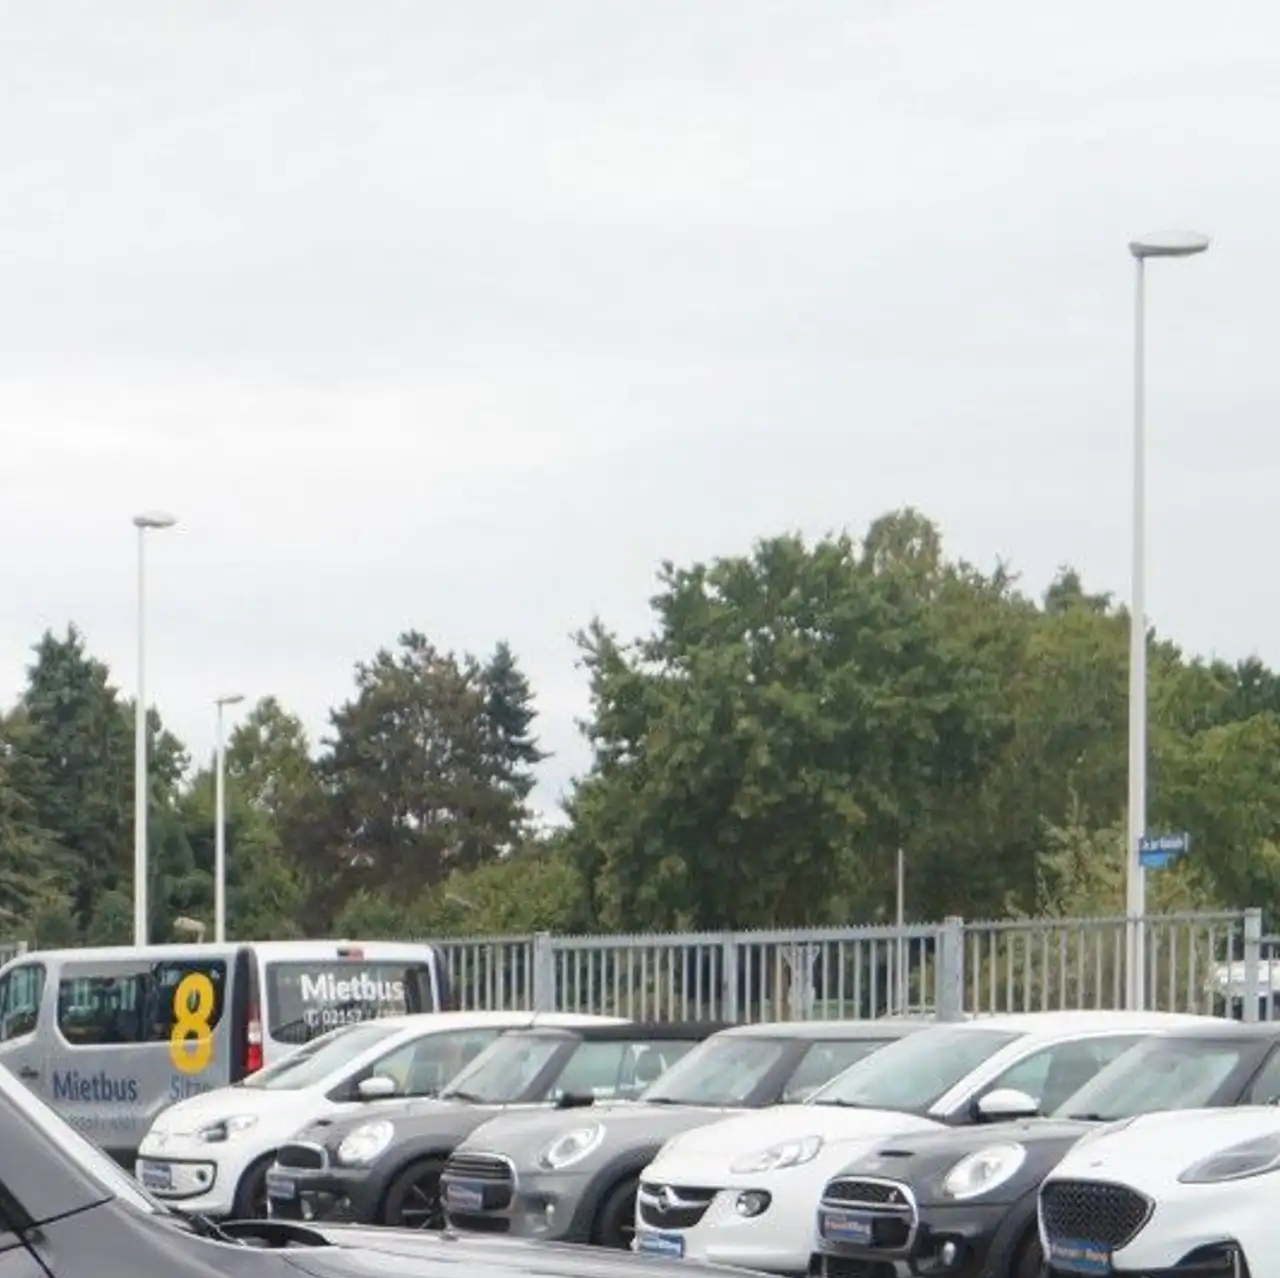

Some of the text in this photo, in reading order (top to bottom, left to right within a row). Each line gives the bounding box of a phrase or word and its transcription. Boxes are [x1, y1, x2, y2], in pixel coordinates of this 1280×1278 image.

[300, 972, 405, 1002] Mietbus
[169, 971, 214, 1075] 8
[52, 1070, 138, 1101] Mietbus
